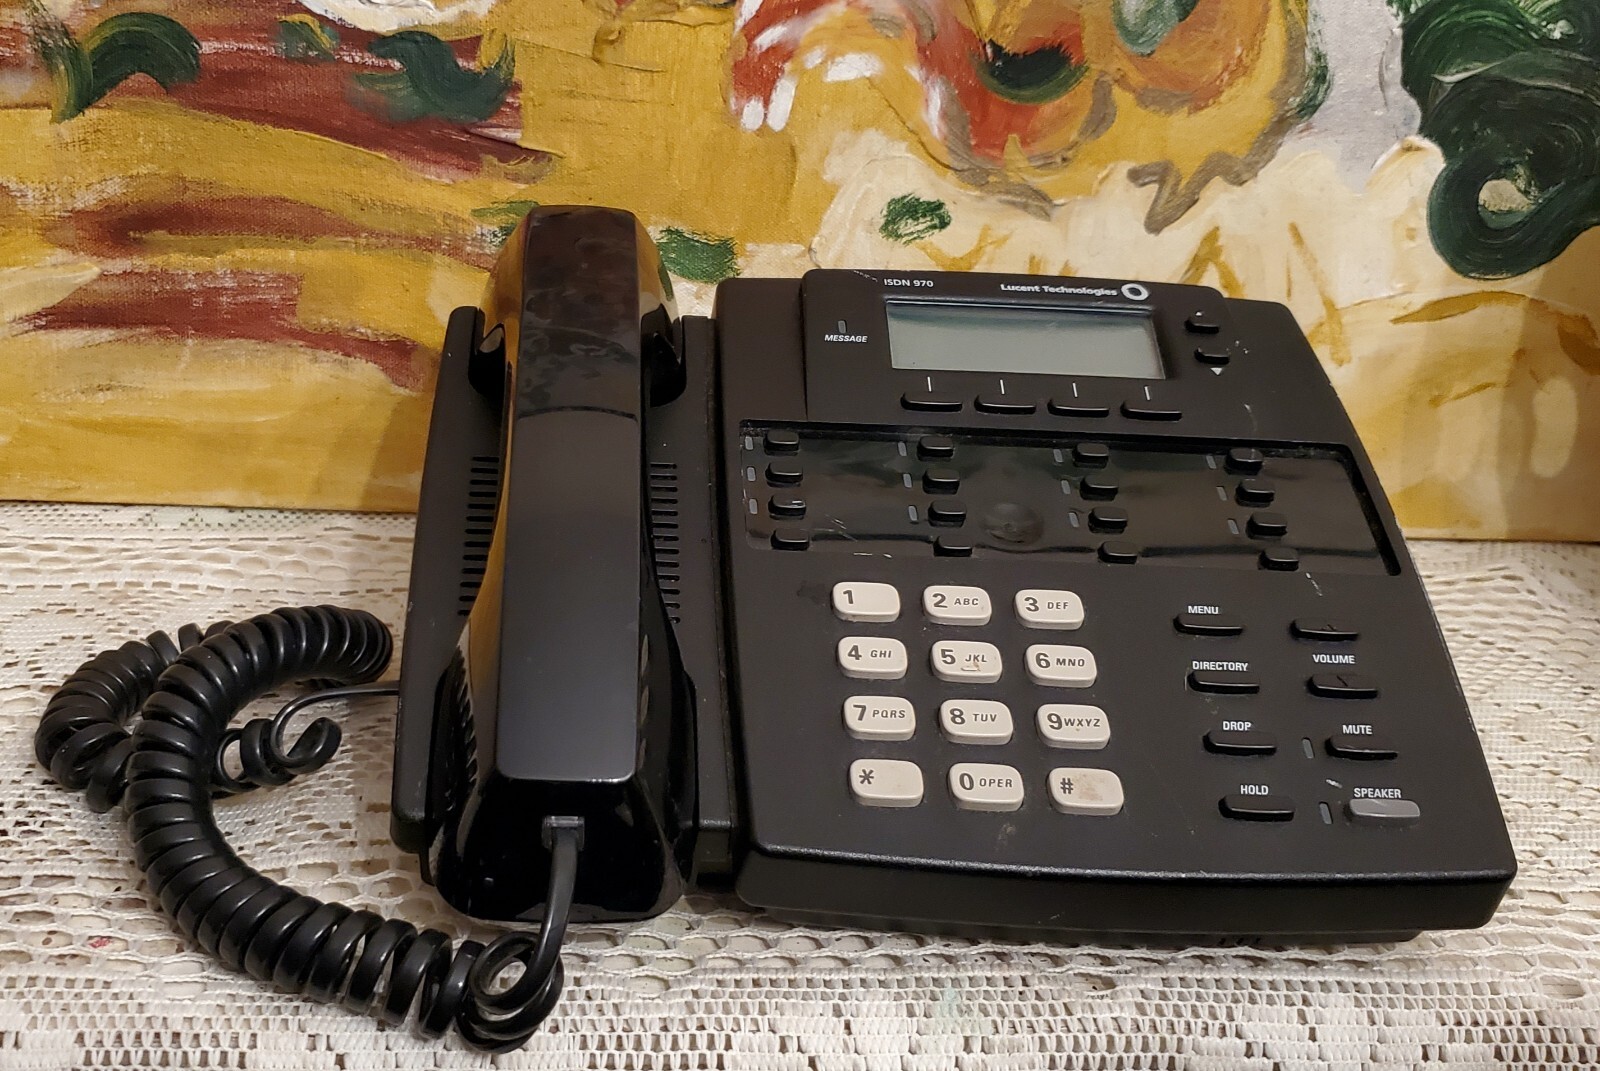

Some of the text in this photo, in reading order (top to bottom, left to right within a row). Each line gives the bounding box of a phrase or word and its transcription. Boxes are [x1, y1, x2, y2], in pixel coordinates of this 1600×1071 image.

[883, 278, 934, 288] ISDN 970
[1000, 283, 1118, 297] Lucent Technologies
[824, 334, 868, 343] MESSAGE
[842, 589, 854, 605] 1
[931, 592, 979, 609] 2 ABC
[1024, 596, 1070, 612] 3 DEF
[1187, 605, 1220, 615] MENU
[847, 644, 893, 661] 4 GHI
[940, 648, 988, 665] 5 JKL
[1035, 652, 1085, 669] 6 MNO
[1312, 653, 1356, 665] VOLUME
[1192, 660, 1249, 672] DIRECTORY
[852, 704, 906, 721] 7 PQRS
[949, 708, 998, 725] 8 TUV
[1047, 712, 1101, 731] 9 WXYZ
[1222, 720, 1252, 731] DROP
[1342, 724, 1373, 735] MUTE
[959, 772, 1013, 791] 0 OPER
[1060, 777, 1074, 795] #
[1240, 784, 1269, 795] HOLD
[1353, 787, 1402, 799] SPEAKER
